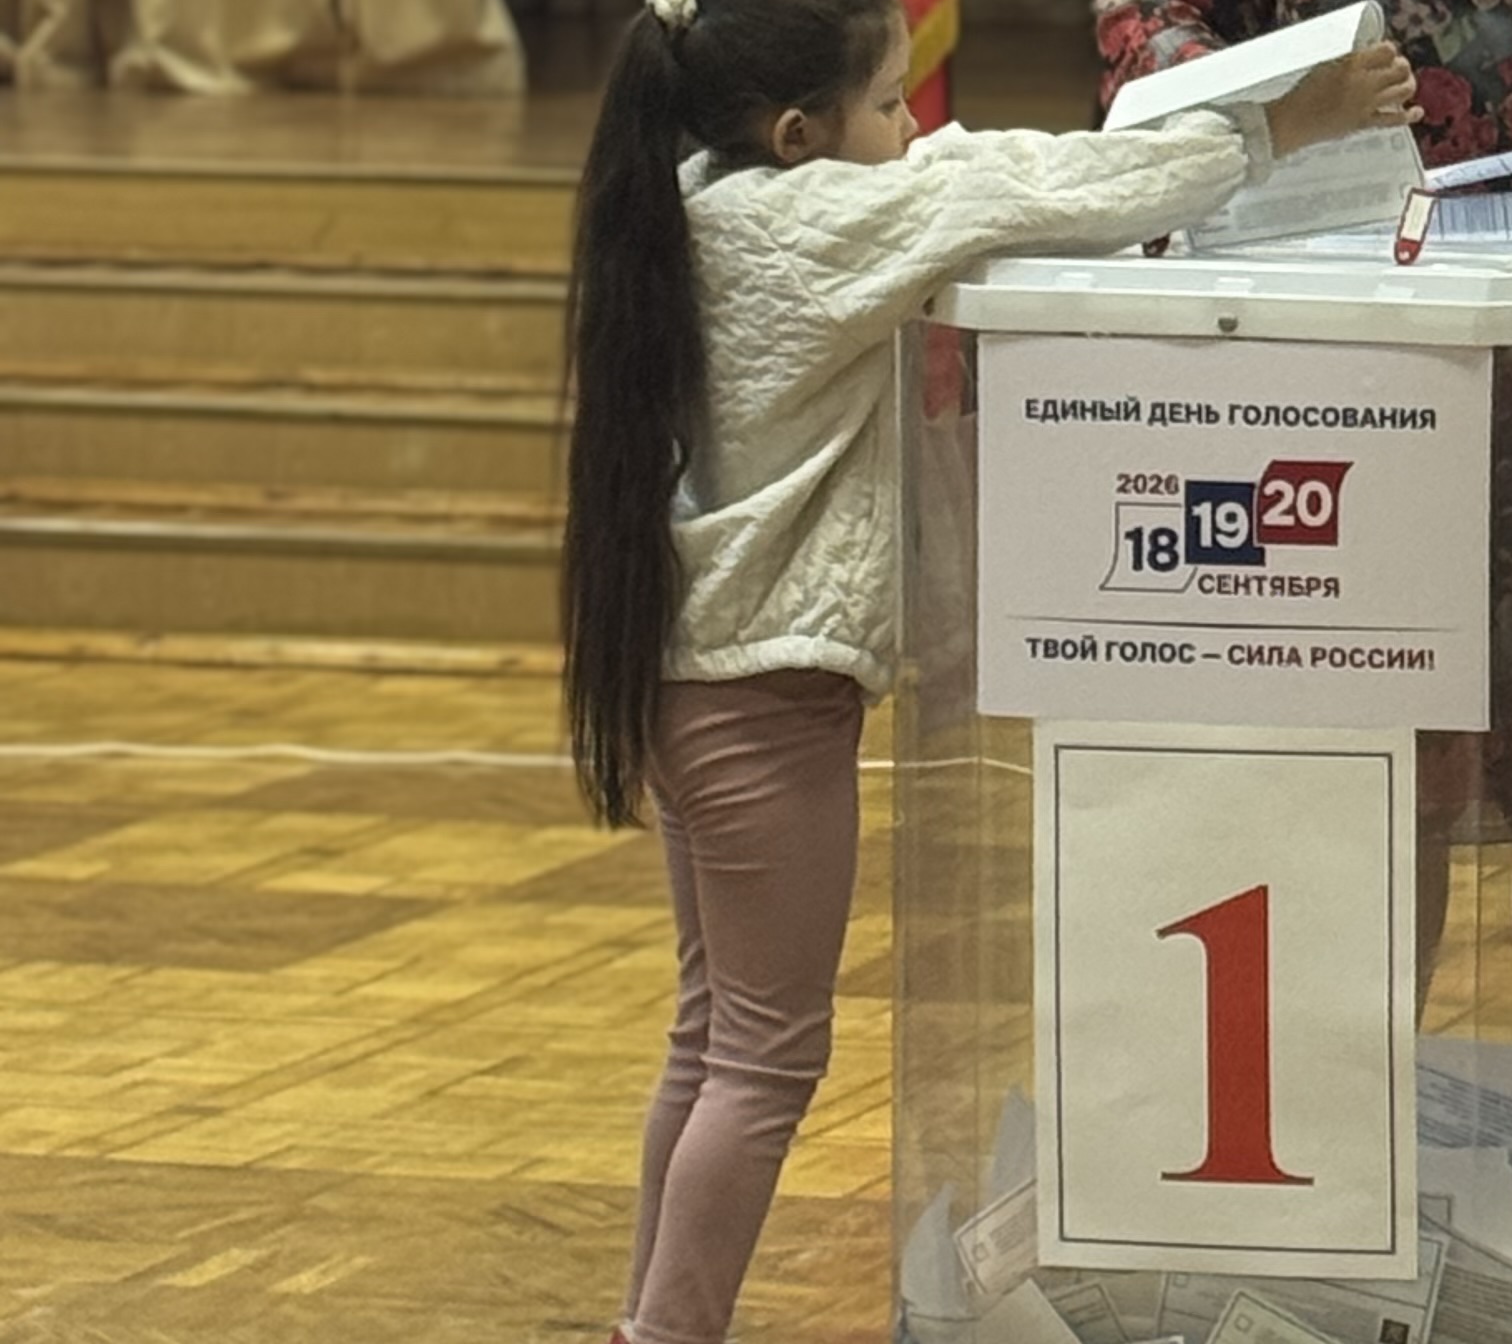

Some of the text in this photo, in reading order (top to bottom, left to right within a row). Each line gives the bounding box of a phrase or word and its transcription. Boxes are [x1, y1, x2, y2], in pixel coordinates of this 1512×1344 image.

[1025, 397, 1437, 430] ЕДИНЫЙ ДЕНЬ ГОЛОСОВАНИЯ
[1116, 474, 1180, 495] 2026
[1125, 480, 1333, 573] 18 19 20
[1197, 574, 1341, 598] СЕНТЯБРЯ
[1026, 635, 1098, 662] ТВОЙ
[1105, 642, 1196, 665] ГОЛОС
[1227, 644, 1303, 667] СИЛА
[1310, 646, 1436, 670] РОССИИ!
[1155, 884, 1315, 1186] 1
